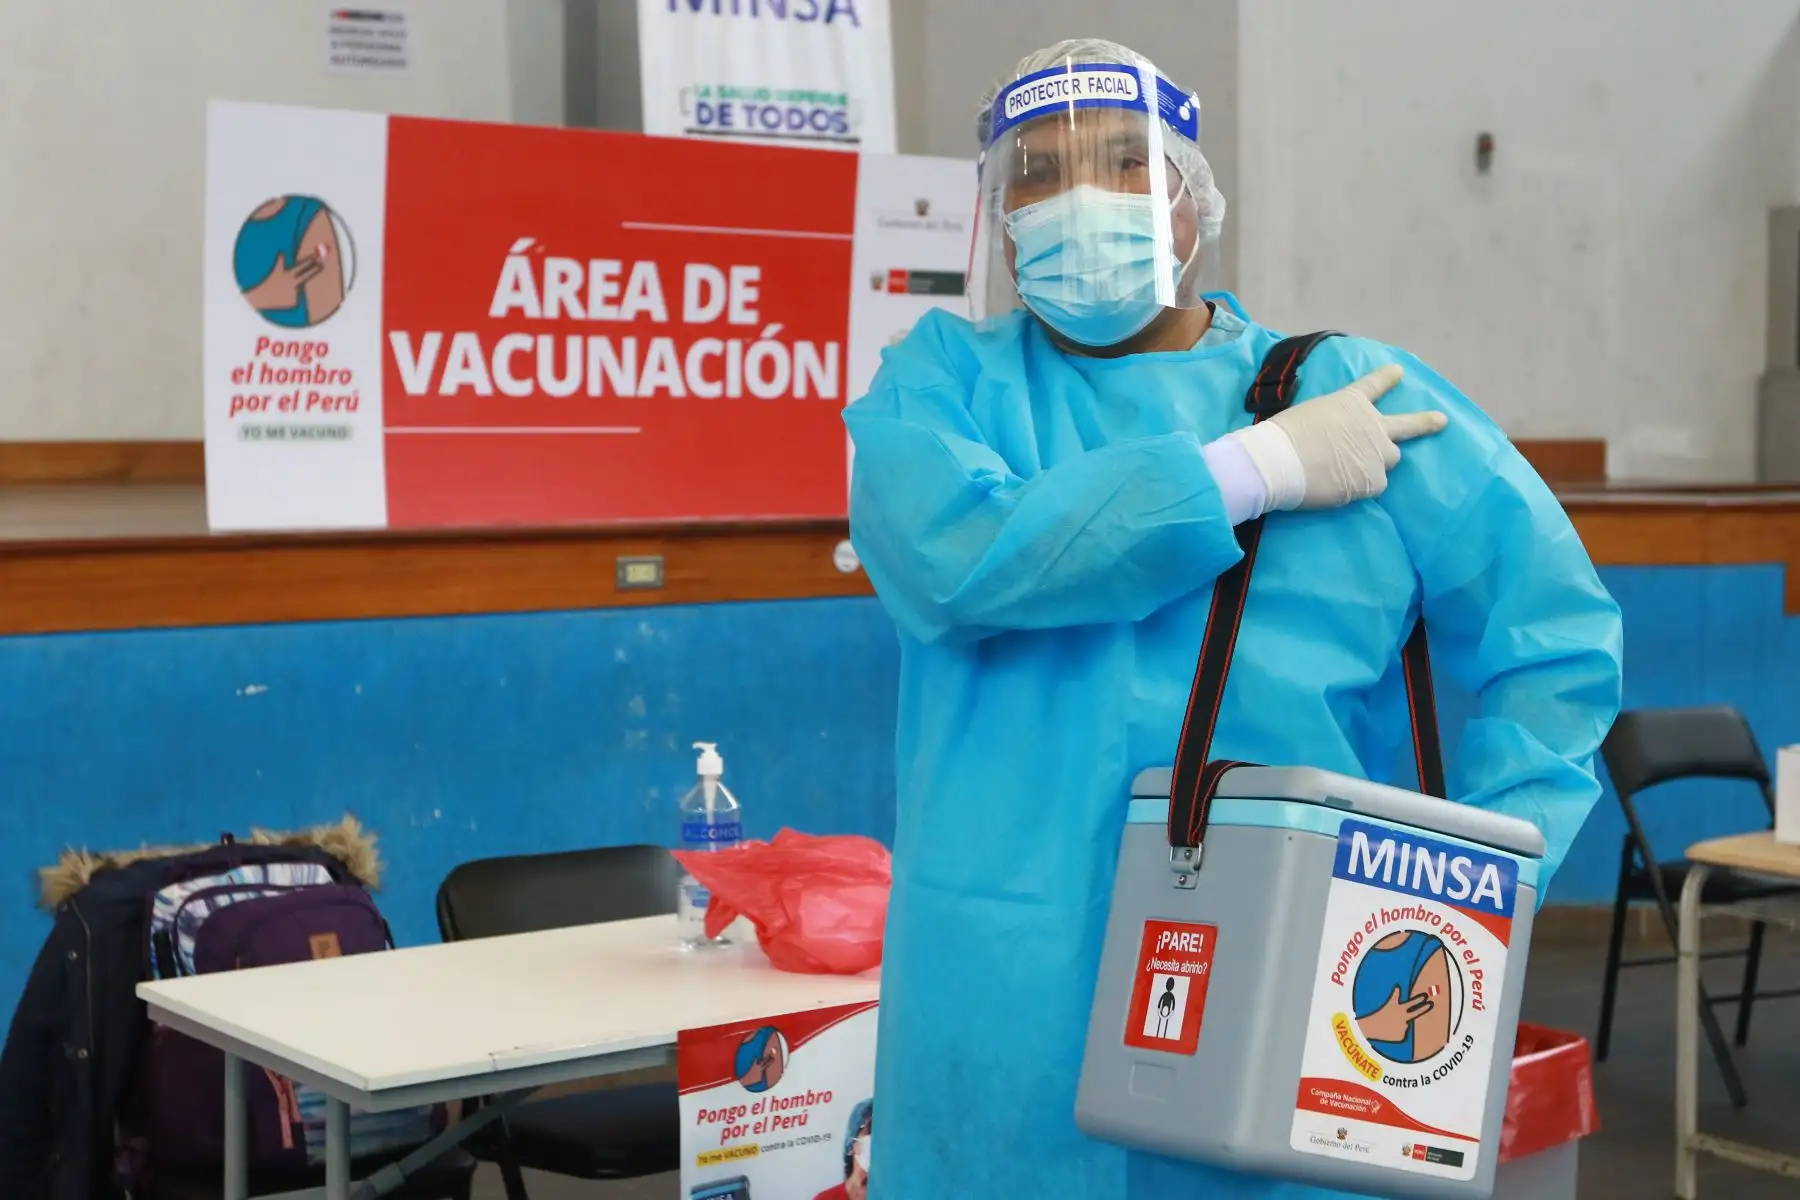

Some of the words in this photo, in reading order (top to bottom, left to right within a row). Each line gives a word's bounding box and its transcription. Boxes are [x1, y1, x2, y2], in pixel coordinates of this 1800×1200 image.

[1009, 79, 1081, 112] PROTECTOR
[1088, 77, 1132, 95] FACIAL
[696, 102, 733, 126] DE
[743, 105, 849, 134] TODOS
[488, 237, 668, 322] ÁREA
[682, 263, 761, 326] DE
[255, 336, 329, 364] Pongo
[389, 323, 839, 399] VACUNACIÓN
[231, 362, 254, 385] el
[259, 363, 352, 385] hombro
[229, 393, 271, 417] por
[278, 390, 299, 411] el
[305, 390, 359, 412] Perú
[266, 427, 286, 438] ME
[290, 427, 349, 438] VACUNO
[1347, 830, 1504, 910] MINSA
[1364, 913, 1378, 935] el
[1380, 904, 1441, 926] hombro
[1156, 930, 1204, 953] ¡PARE!
[1439, 922, 1468, 947] por
[1146, 957, 1180, 973] ¿Necesita
[1181, 960, 1208, 975] abrirlo?
[1331, 931, 1364, 987] Pongo
[1462, 949, 1480, 965] el
[1469, 969, 1485, 1011] Perú
[1336, 1020, 1380, 1079] VACÚNATE
[1382, 1074, 1418, 1088] contra
[1421, 1075, 1431, 1086] la
[1433, 1034, 1474, 1081] COVID-19
[696, 1104, 746, 1125] Pongo
[751, 1097, 766, 1115] el
[769, 1089, 833, 1113] hombro
[1311, 1088, 1342, 1101] Campaña
[1343, 1094, 1371, 1105] Nacional
[1330, 1100, 1367, 1112] Vacunación
[719, 1123, 749, 1145] por
[753, 1117, 767, 1134] el
[771, 1109, 808, 1131] Perú
[709, 1153, 722, 1161] me
[724, 1146, 757, 1159] VACUNO
[760, 1143, 786, 1153] contra
[787, 1140, 795, 1148] la
[1310, 1136, 1341, 1148] Gobierno
[1342, 1142, 1353, 1150] del
